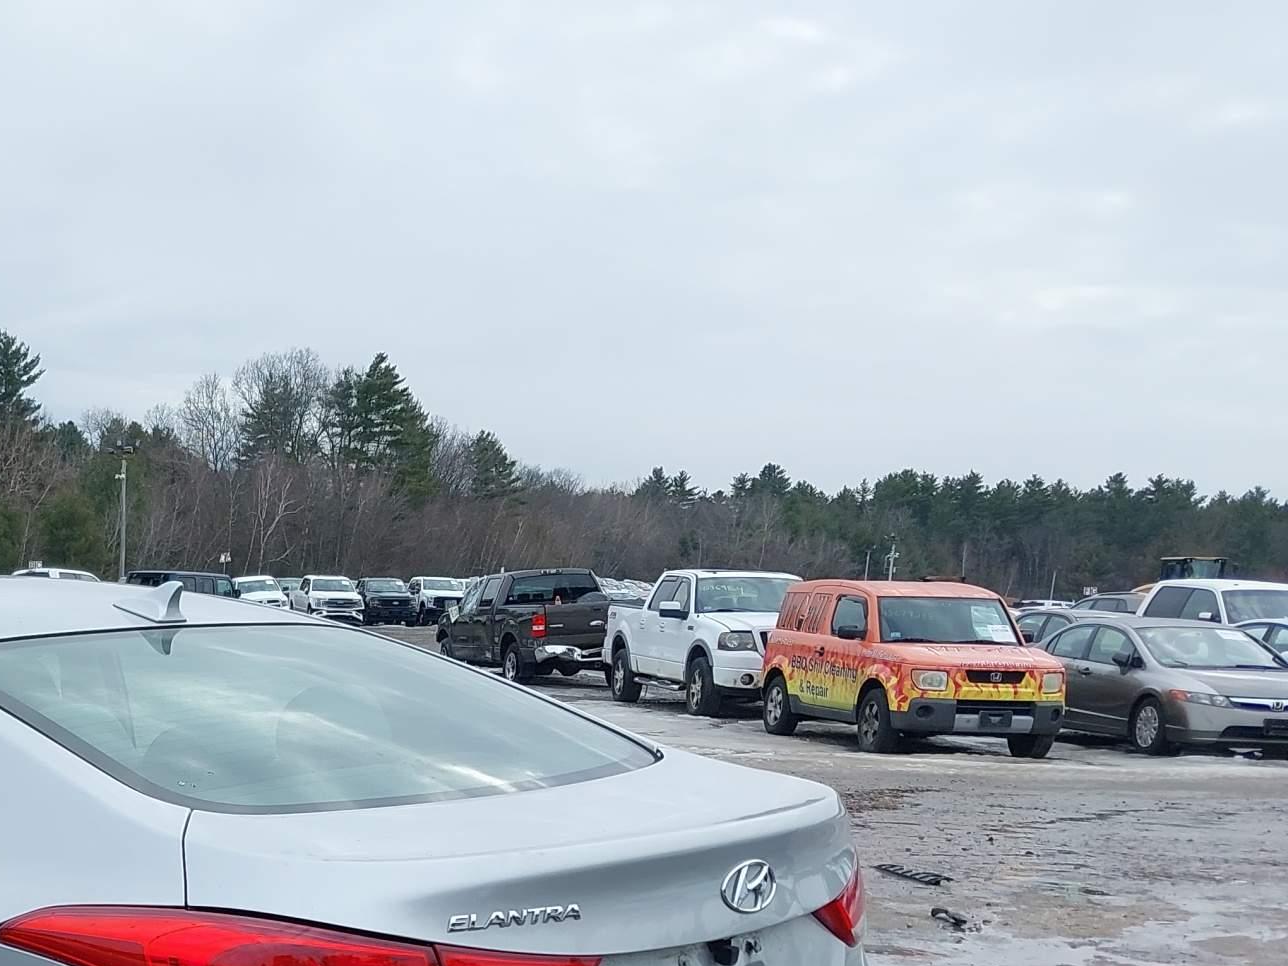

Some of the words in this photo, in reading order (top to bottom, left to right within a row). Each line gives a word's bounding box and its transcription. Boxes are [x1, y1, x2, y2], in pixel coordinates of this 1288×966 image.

[792, 654, 807, 670] BBQ
[823, 660, 857, 683] Cleaning
[806, 680, 829, 699] Repair
[447, 903, 582, 933] ELANTRA
